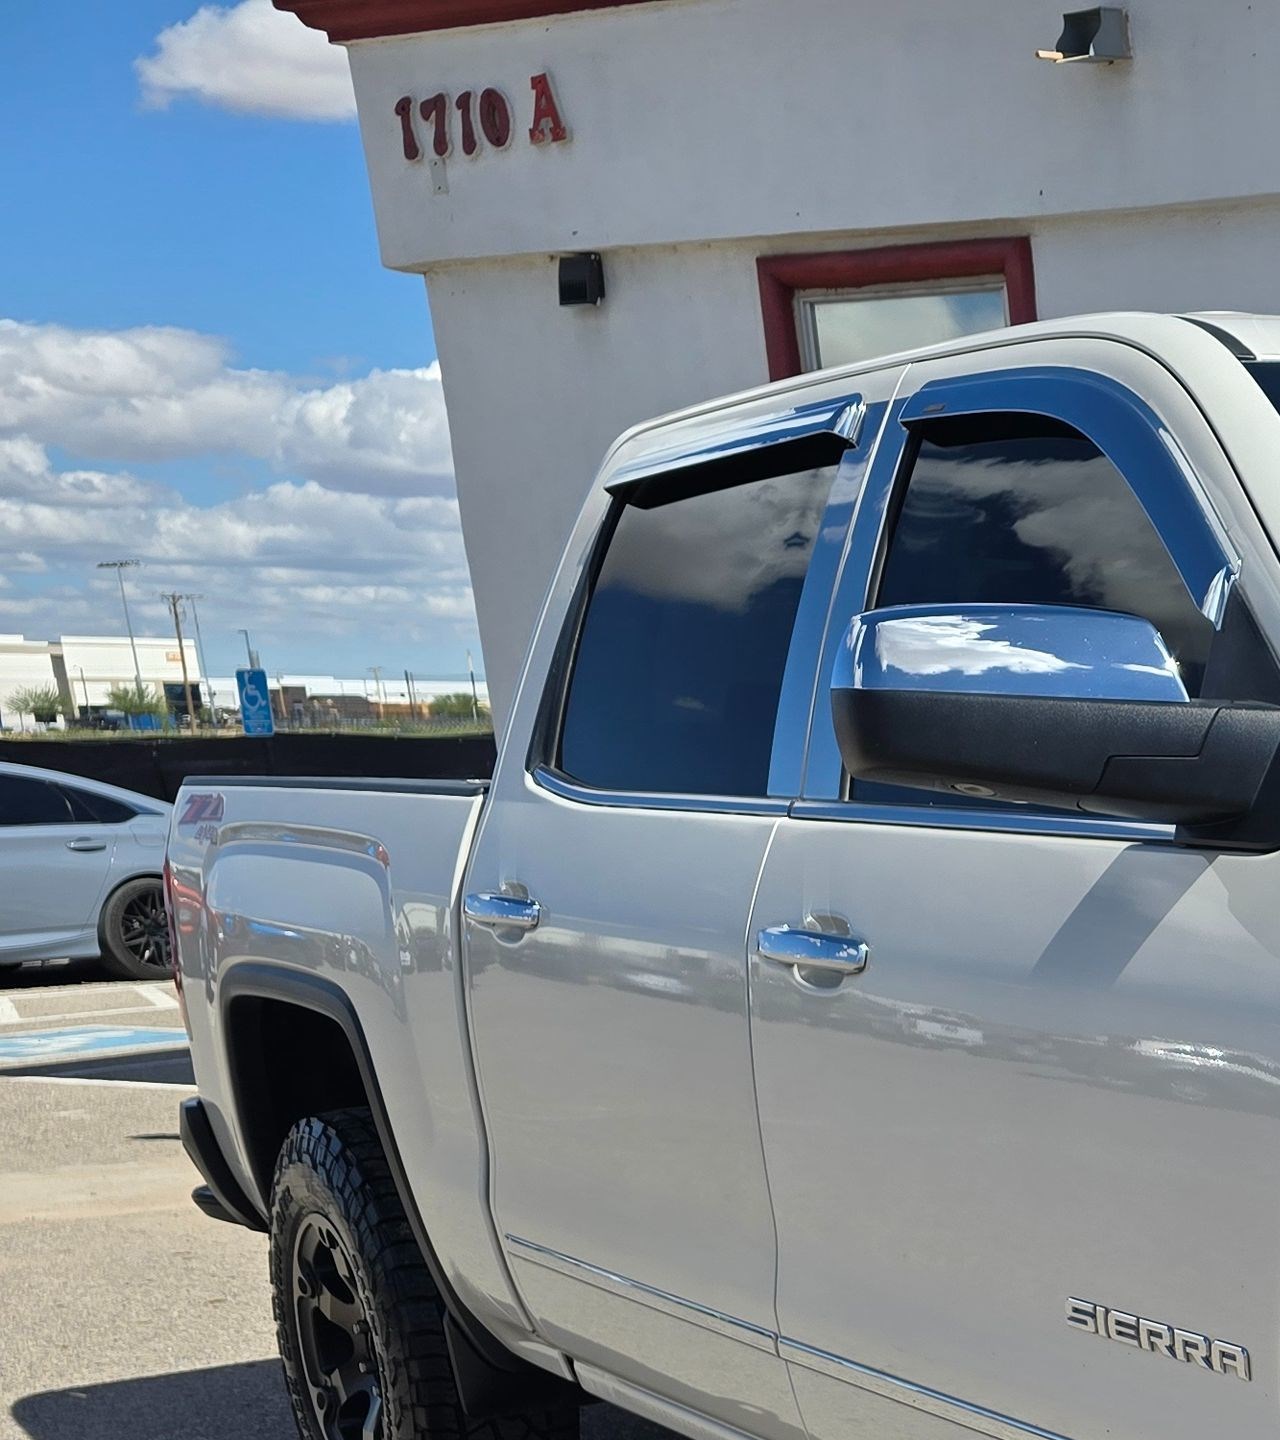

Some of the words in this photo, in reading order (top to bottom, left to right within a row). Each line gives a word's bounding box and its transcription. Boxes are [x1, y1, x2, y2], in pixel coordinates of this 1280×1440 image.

[395, 88, 509, 160] 1710
[529, 72, 567, 144] A
[1065, 1296, 1252, 1382] SIERRA
